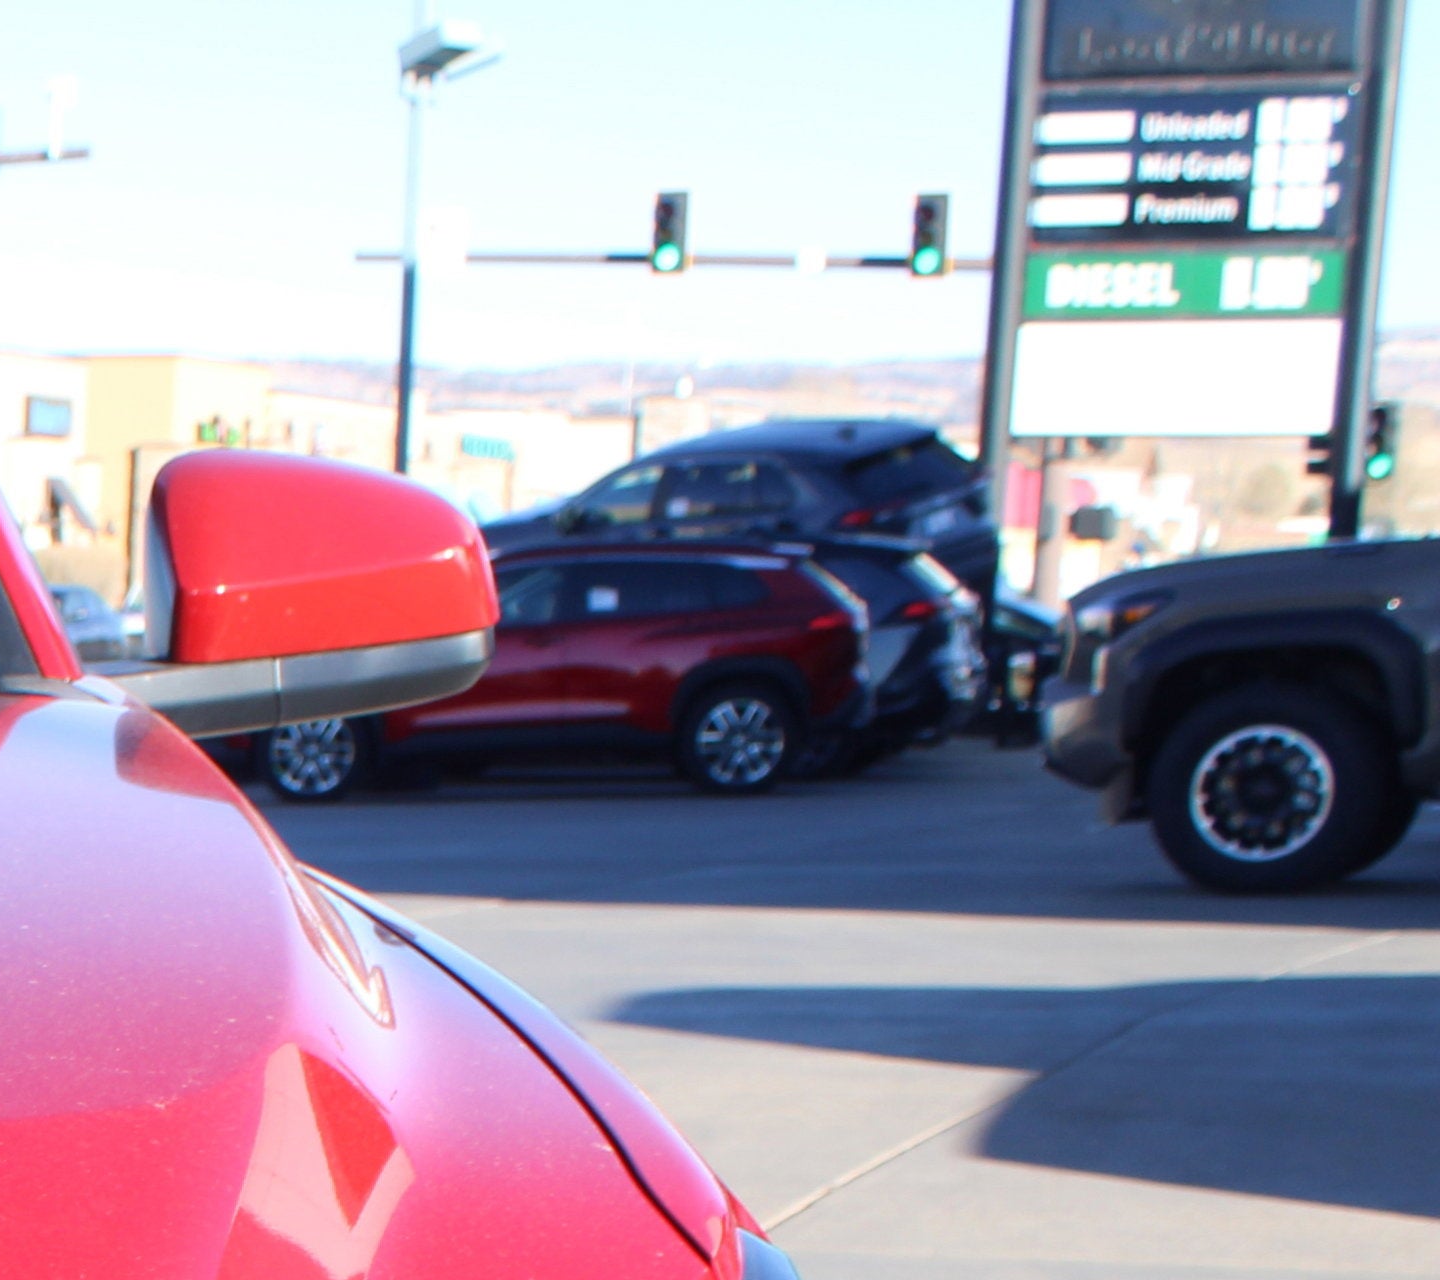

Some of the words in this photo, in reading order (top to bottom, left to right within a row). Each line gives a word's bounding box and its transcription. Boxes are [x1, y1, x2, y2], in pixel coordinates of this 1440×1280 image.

[1140, 109, 1251, 142] Unleaded
[1133, 193, 1240, 224] Premium
[1045, 261, 1181, 308] DIESEL
